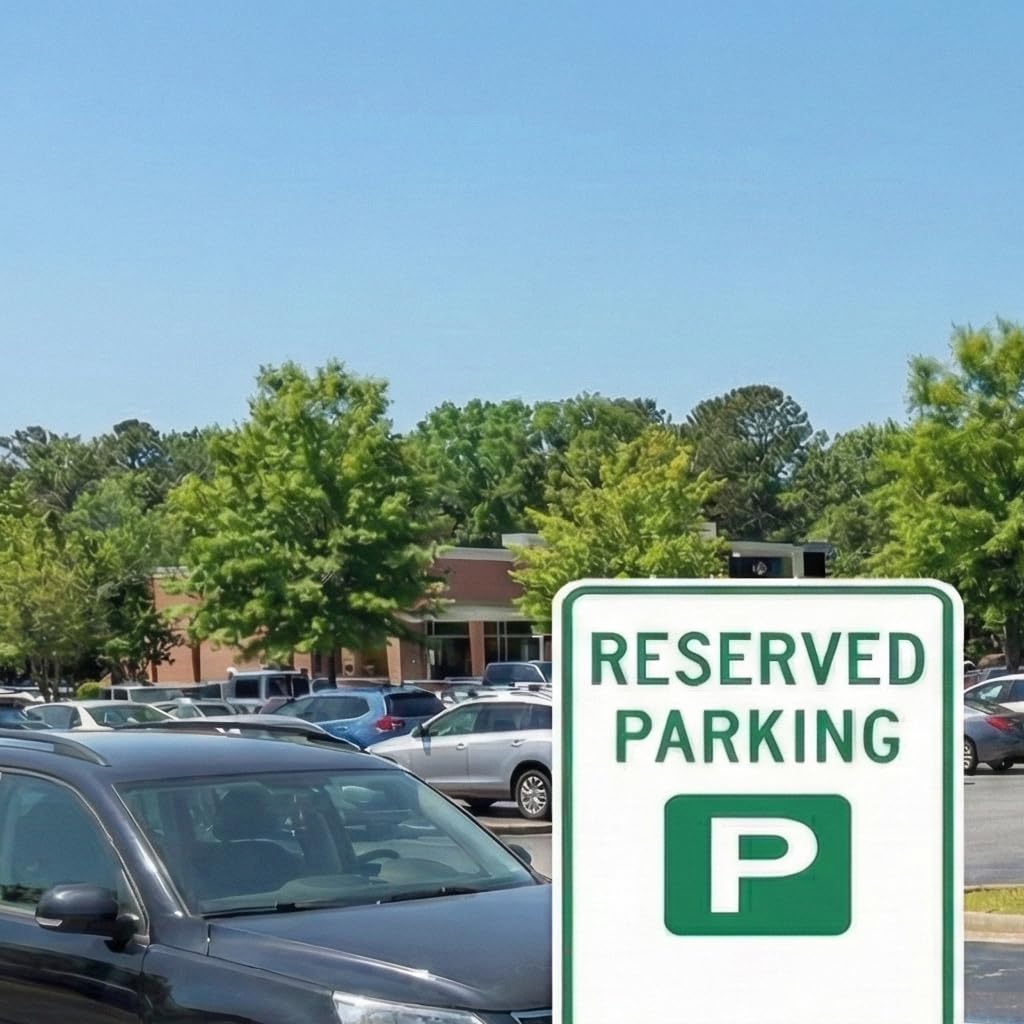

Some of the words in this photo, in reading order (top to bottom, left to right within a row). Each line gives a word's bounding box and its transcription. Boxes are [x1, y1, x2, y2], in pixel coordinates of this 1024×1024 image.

[592, 632, 925, 686] RESERVED
[616, 709, 900, 763] PARKING
[710, 817, 818, 913] P
